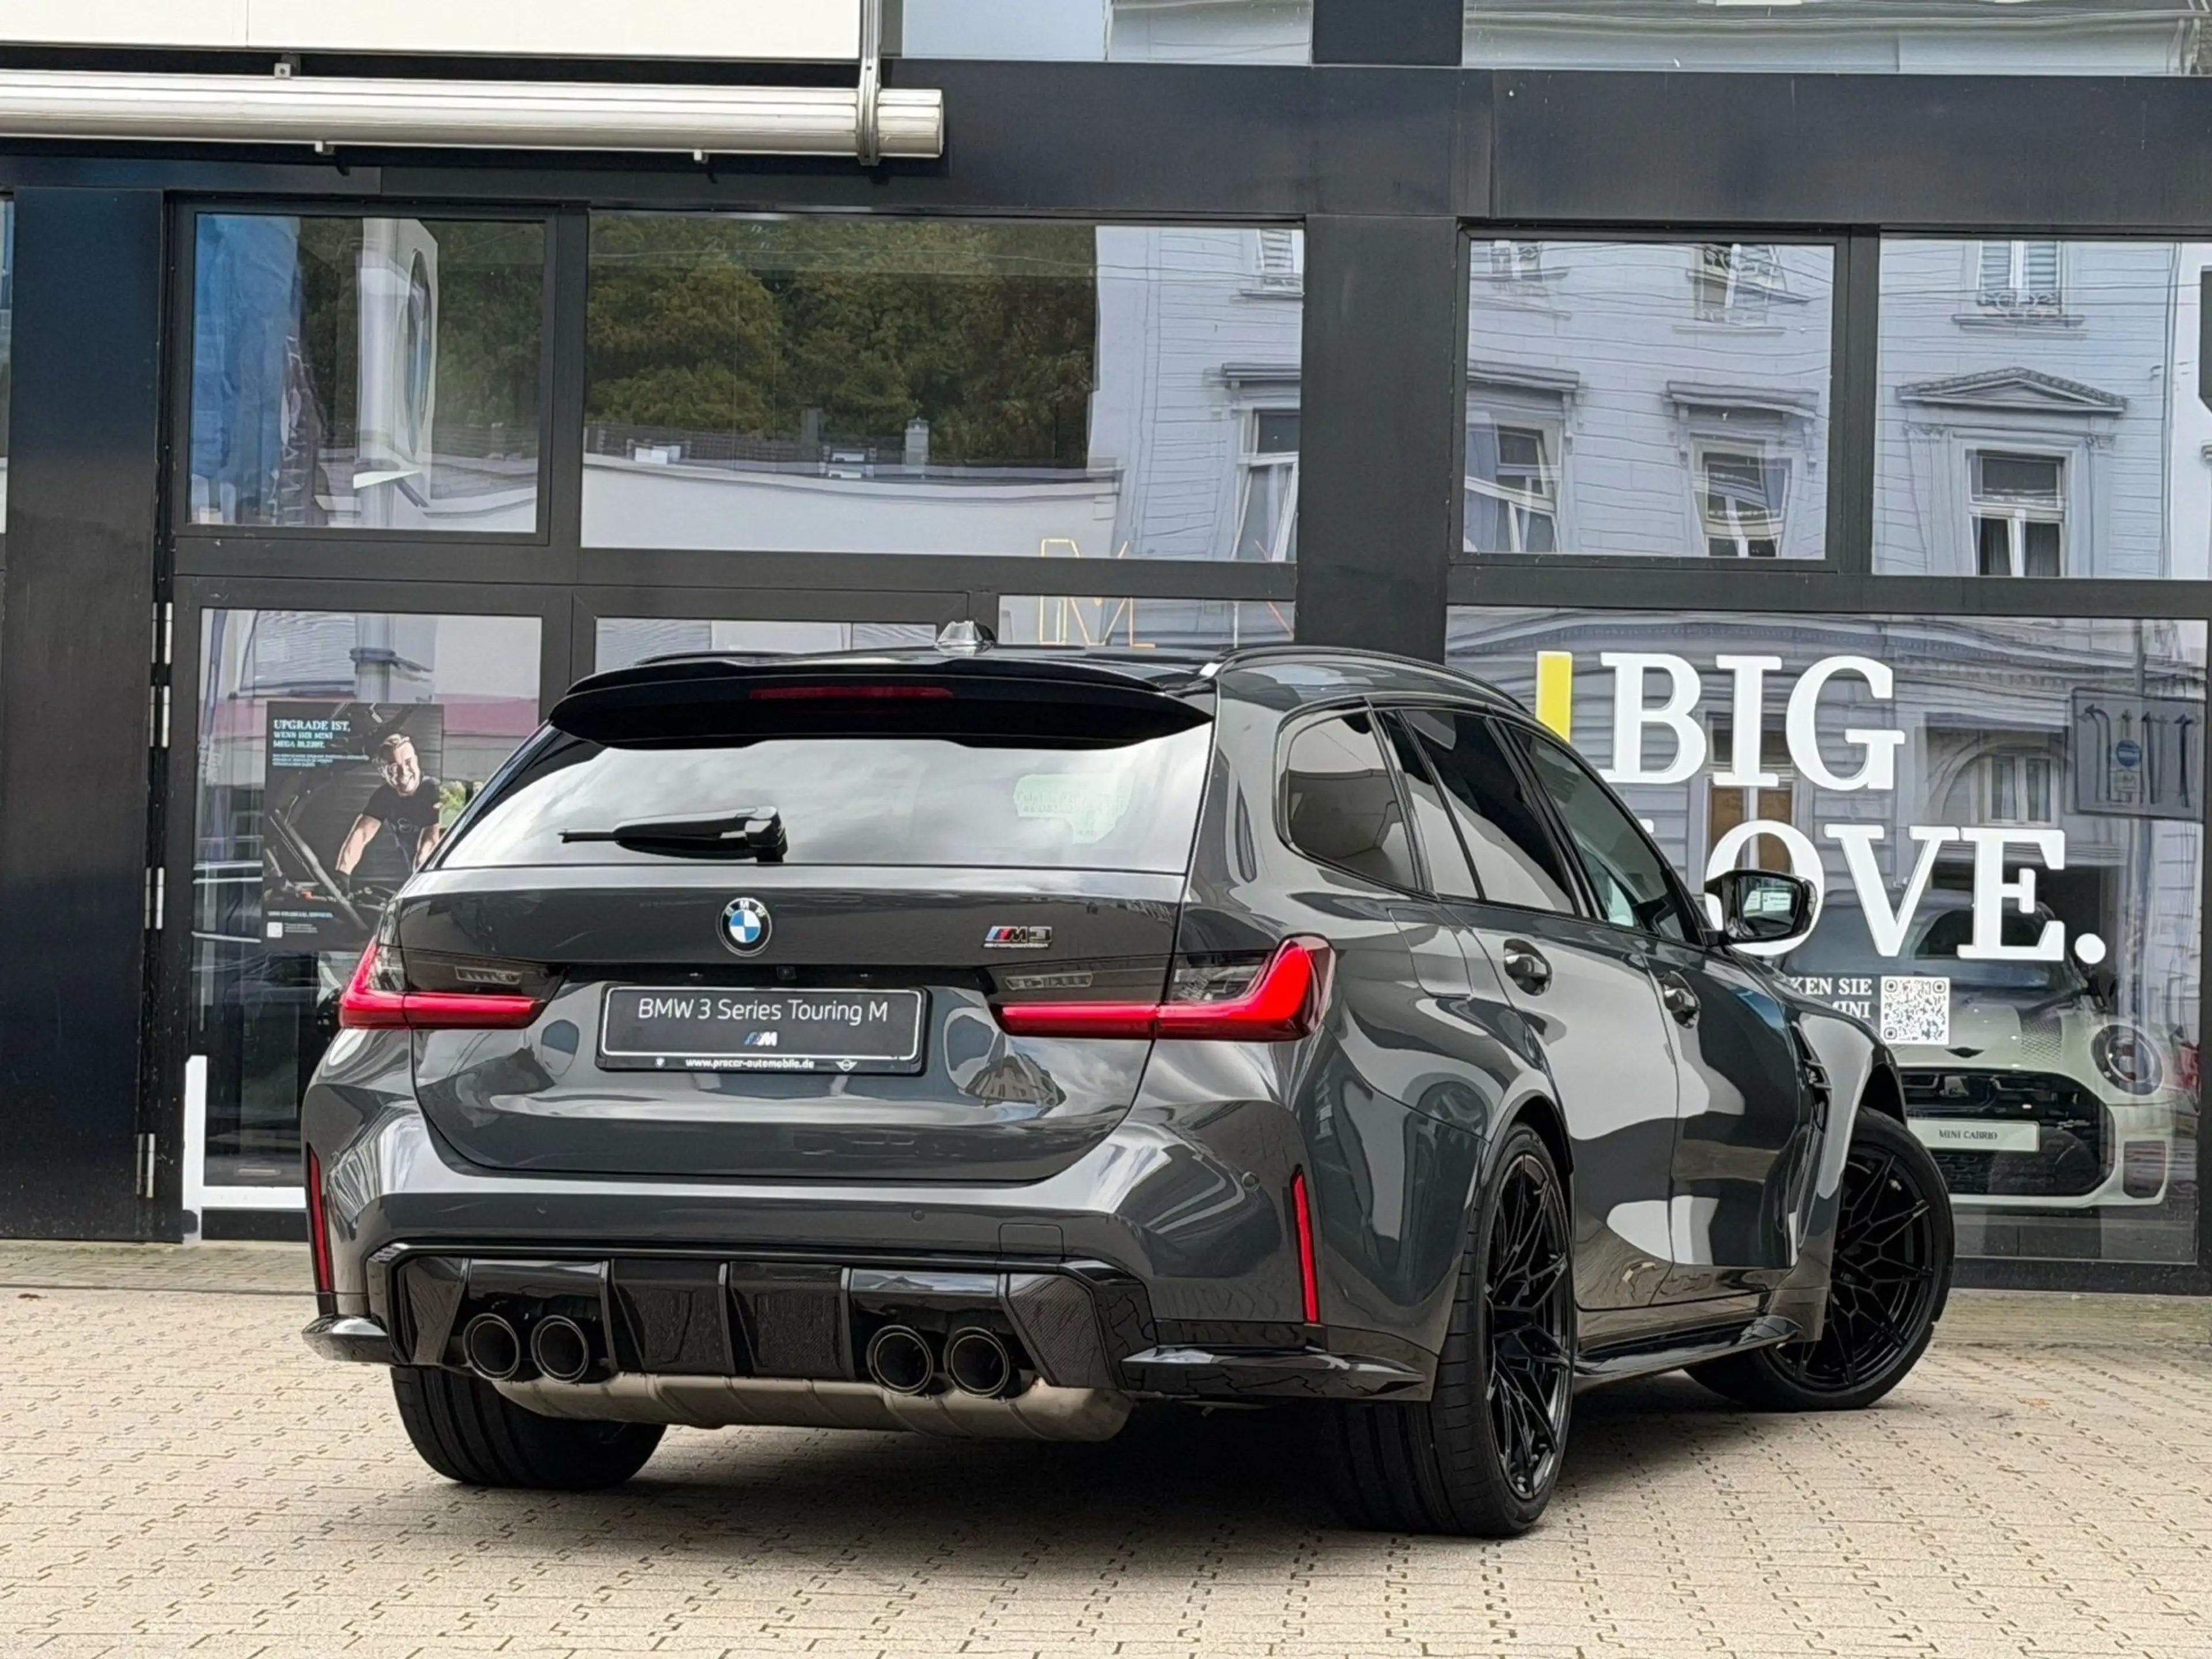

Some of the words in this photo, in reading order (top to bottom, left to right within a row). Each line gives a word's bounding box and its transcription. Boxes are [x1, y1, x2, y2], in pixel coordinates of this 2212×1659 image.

[274, 719, 328, 730] UPGRADE
[331, 721, 351, 732] IST,
[1598, 652, 1905, 790] BIG
[1639, 819, 2107, 964] OVE.
[1838, 977, 1872, 995] SIE
[638, 998, 694, 1019] BMW
[697, 998, 711, 1019] 3
[717, 999, 782, 1020] Series
[787, 999, 862, 1026] Touring
[869, 1001, 888, 1022] M
[1939, 1130, 1961, 1139] MINI
